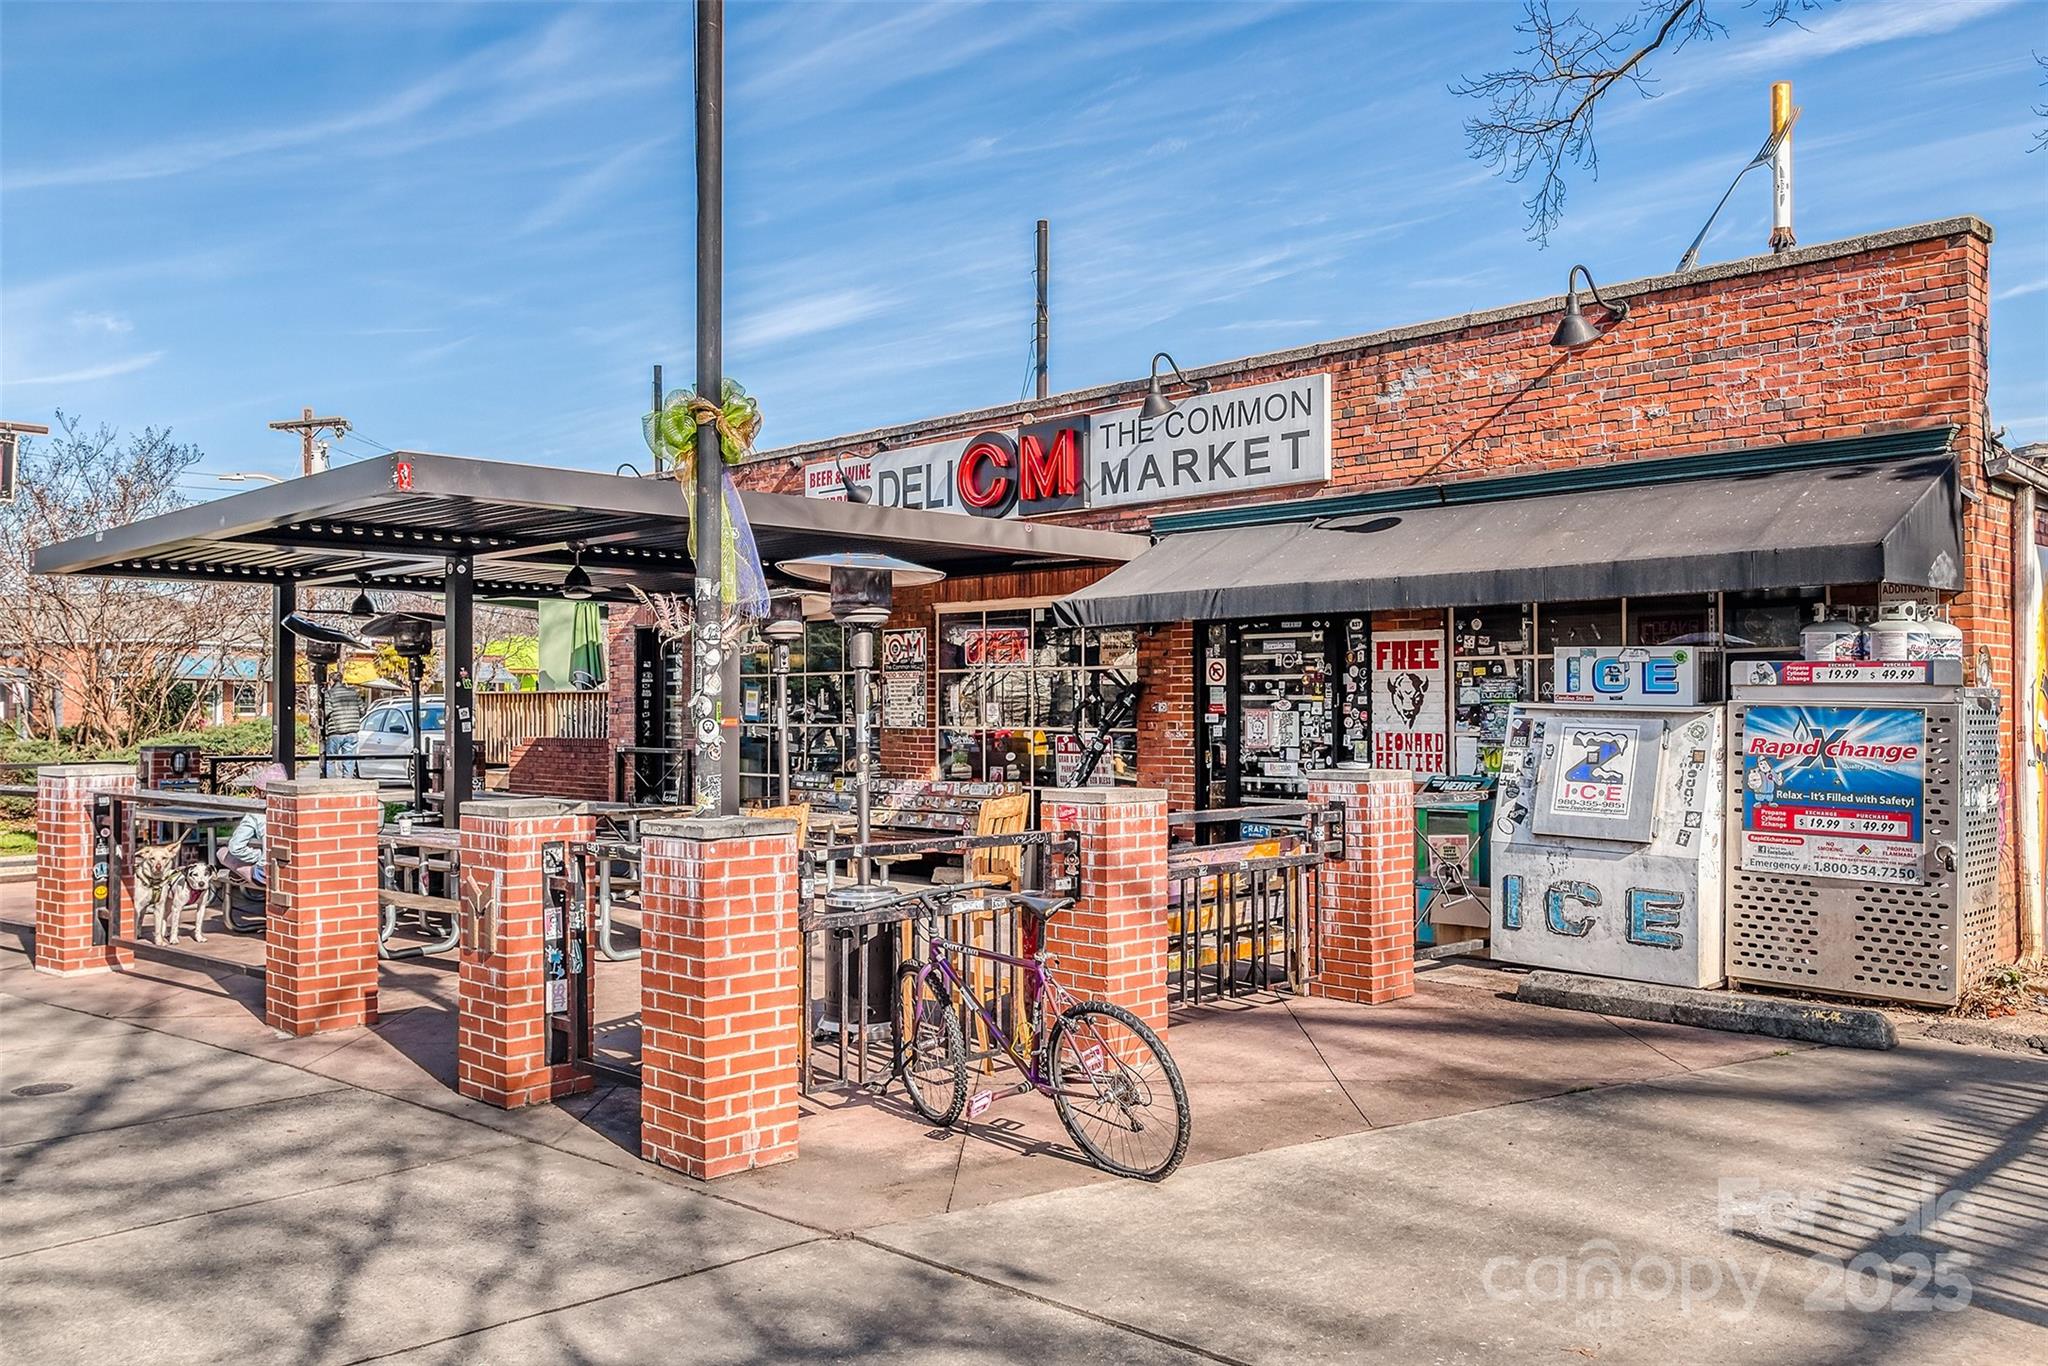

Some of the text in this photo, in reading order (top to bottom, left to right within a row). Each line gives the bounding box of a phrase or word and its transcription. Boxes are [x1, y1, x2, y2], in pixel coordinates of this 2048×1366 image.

[1100, 388, 1312, 449] THE COMMON
[958, 428, 1075, 508] CM
[1101, 430, 1310, 495] MARKET
[809, 463, 872, 489] BEER & WINE
[878, 460, 953, 510] DELI
[1376, 639, 1439, 670] FREE
[1567, 655, 1680, 694] ICE
[1828, 669, 1859, 679] 19.99
[1882, 669, 1915, 680] 49.99
[1376, 732, 1444, 752] LEONARD
[1376, 752, 1443, 773] PELTIER
[1440, 781, 1481, 791] NERVE
[1557, 798, 1625, 809] 980-355-9851
[1826, 793, 1853, 803] Filled
[1855, 795, 1878, 804] with
[1879, 796, 1915, 807] Safety!
[1242, 825, 1270, 835] CRAFT
[1809, 818, 1840, 829] 19.99
[1850, 821, 1855, 829] $
[1862, 822, 1895, 832] 49.99
[1750, 858, 1800, 871] Emergency
[1814, 861, 1915, 880] 1.800.354.7250
[1502, 874, 1685, 951] ICE
